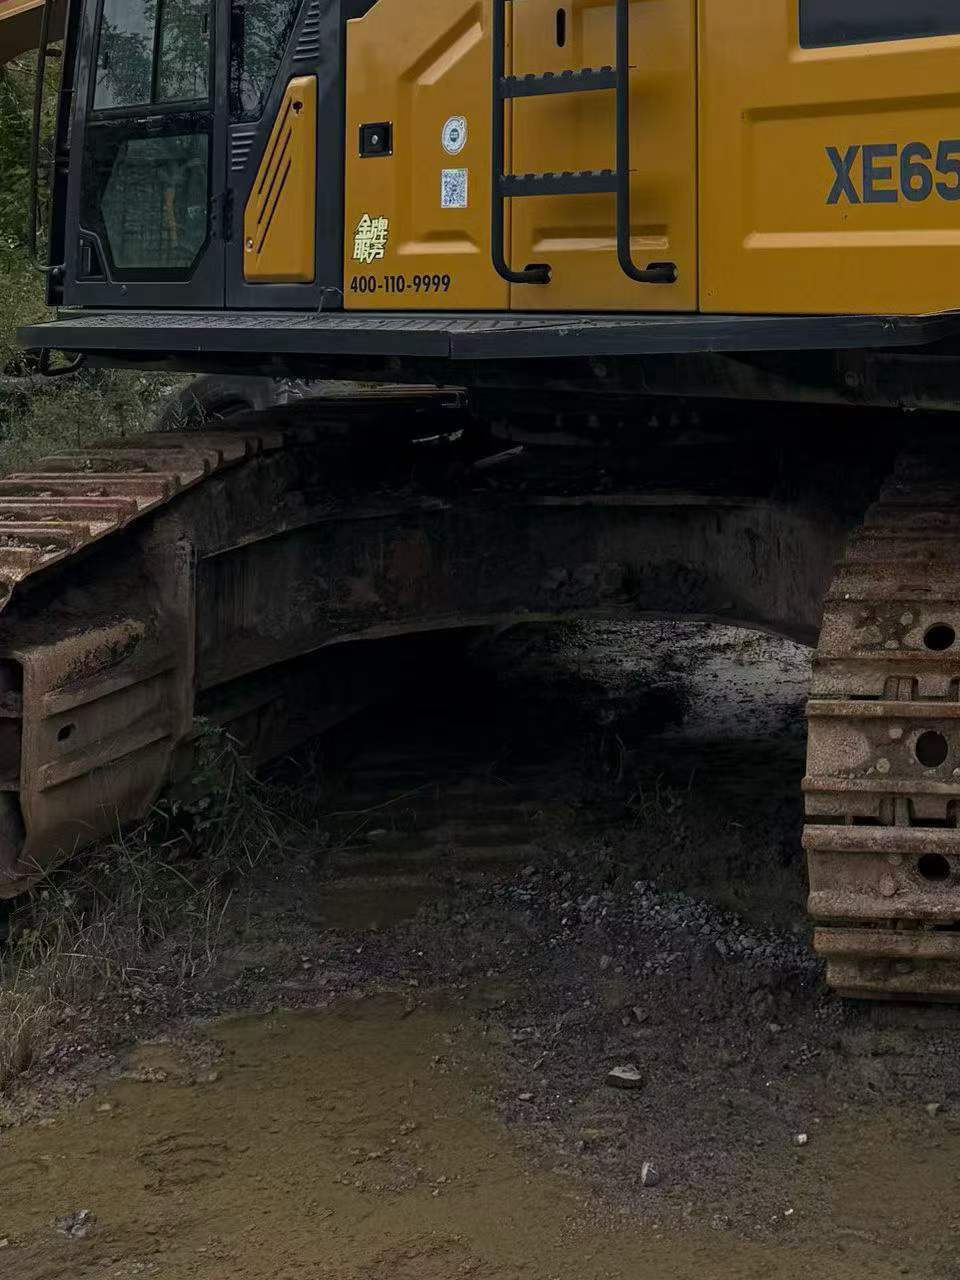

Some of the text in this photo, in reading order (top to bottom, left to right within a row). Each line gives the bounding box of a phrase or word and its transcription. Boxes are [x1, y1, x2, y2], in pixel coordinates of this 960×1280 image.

[355, 213, 389, 243] 金牌
[352, 238, 386, 264] 服务
[350, 274, 451, 293] 400-110-9999
